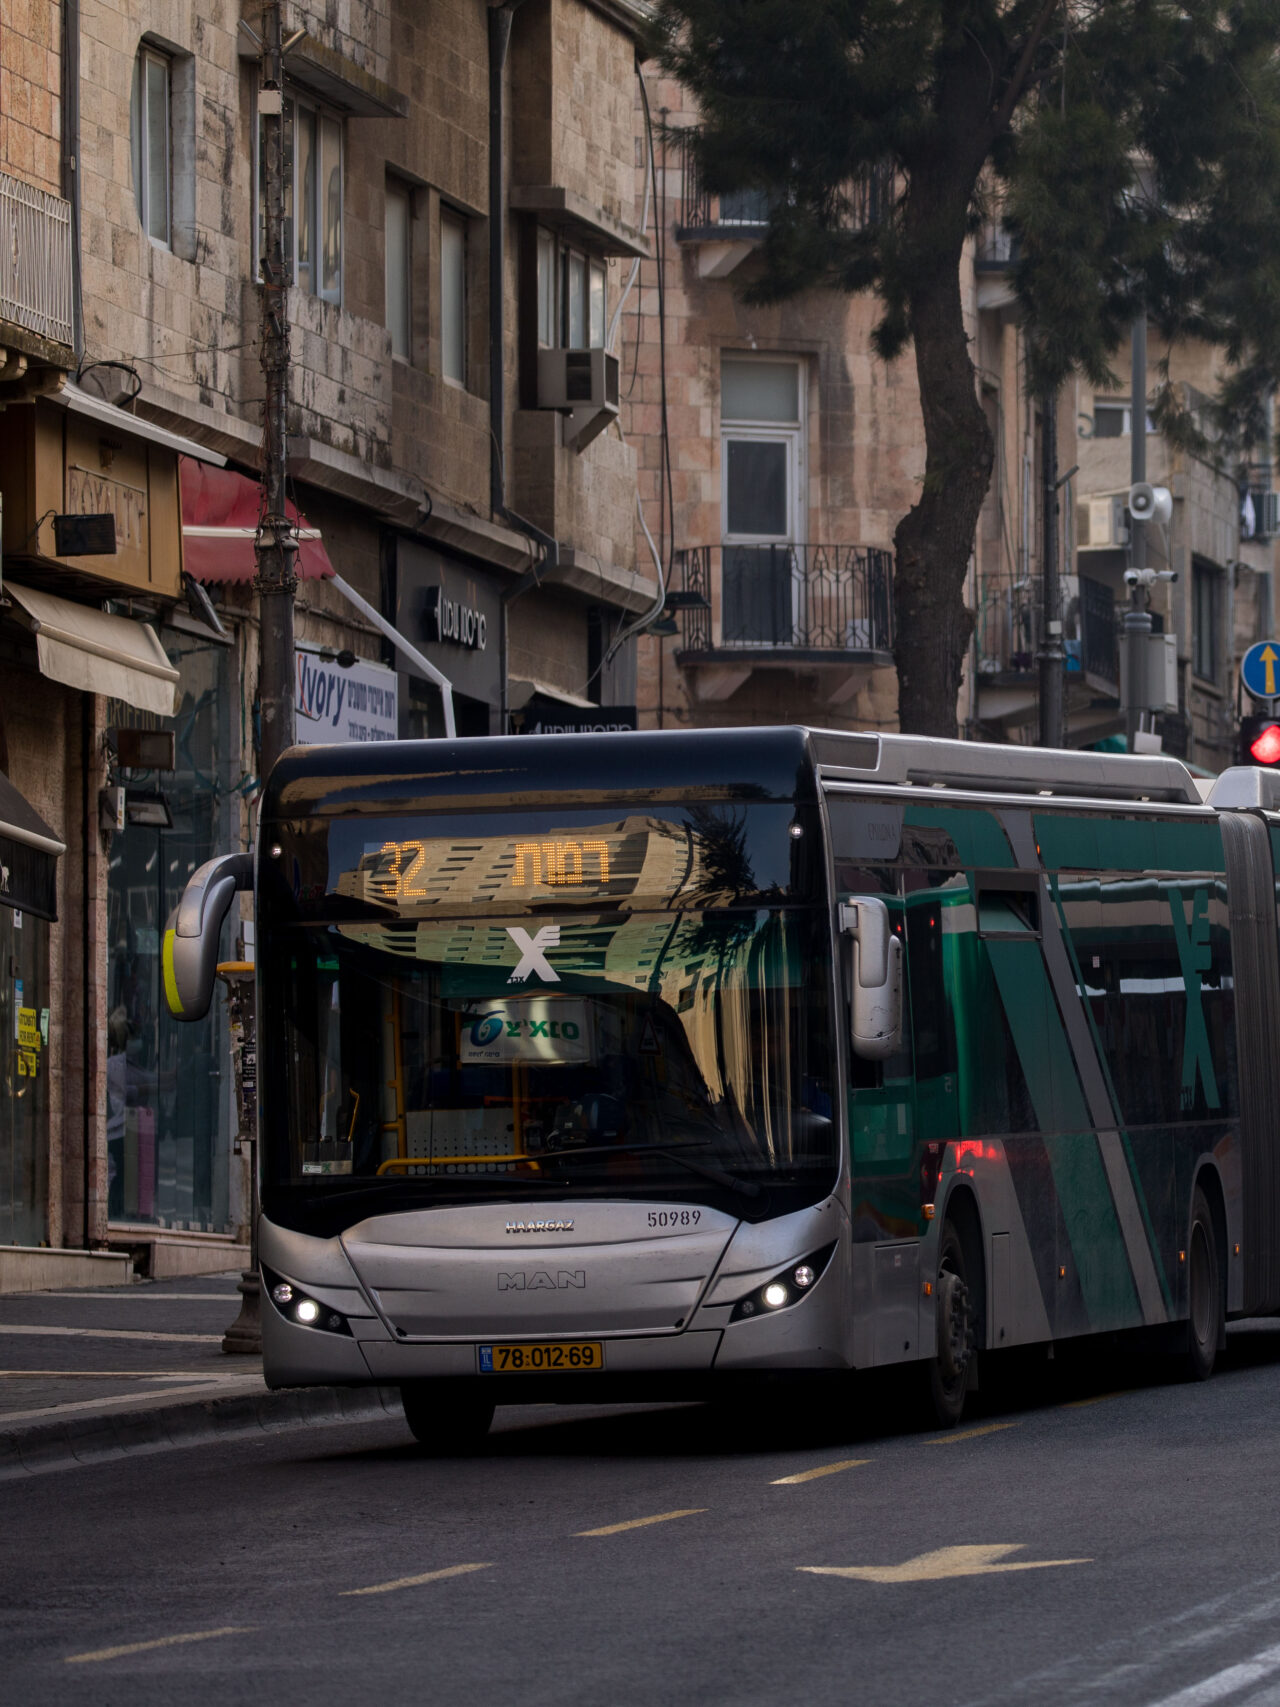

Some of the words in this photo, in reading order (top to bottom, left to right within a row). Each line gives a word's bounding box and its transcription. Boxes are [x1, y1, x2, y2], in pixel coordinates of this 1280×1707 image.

[299, 654, 347, 727] Ivory
[381, 841, 427, 897] 32
[511, 840, 609, 887] רמות
[505, 1218, 575, 1234] HAARGAZ
[647, 1210, 702, 1228] 50989
[497, 1270, 586, 1291] MAN
